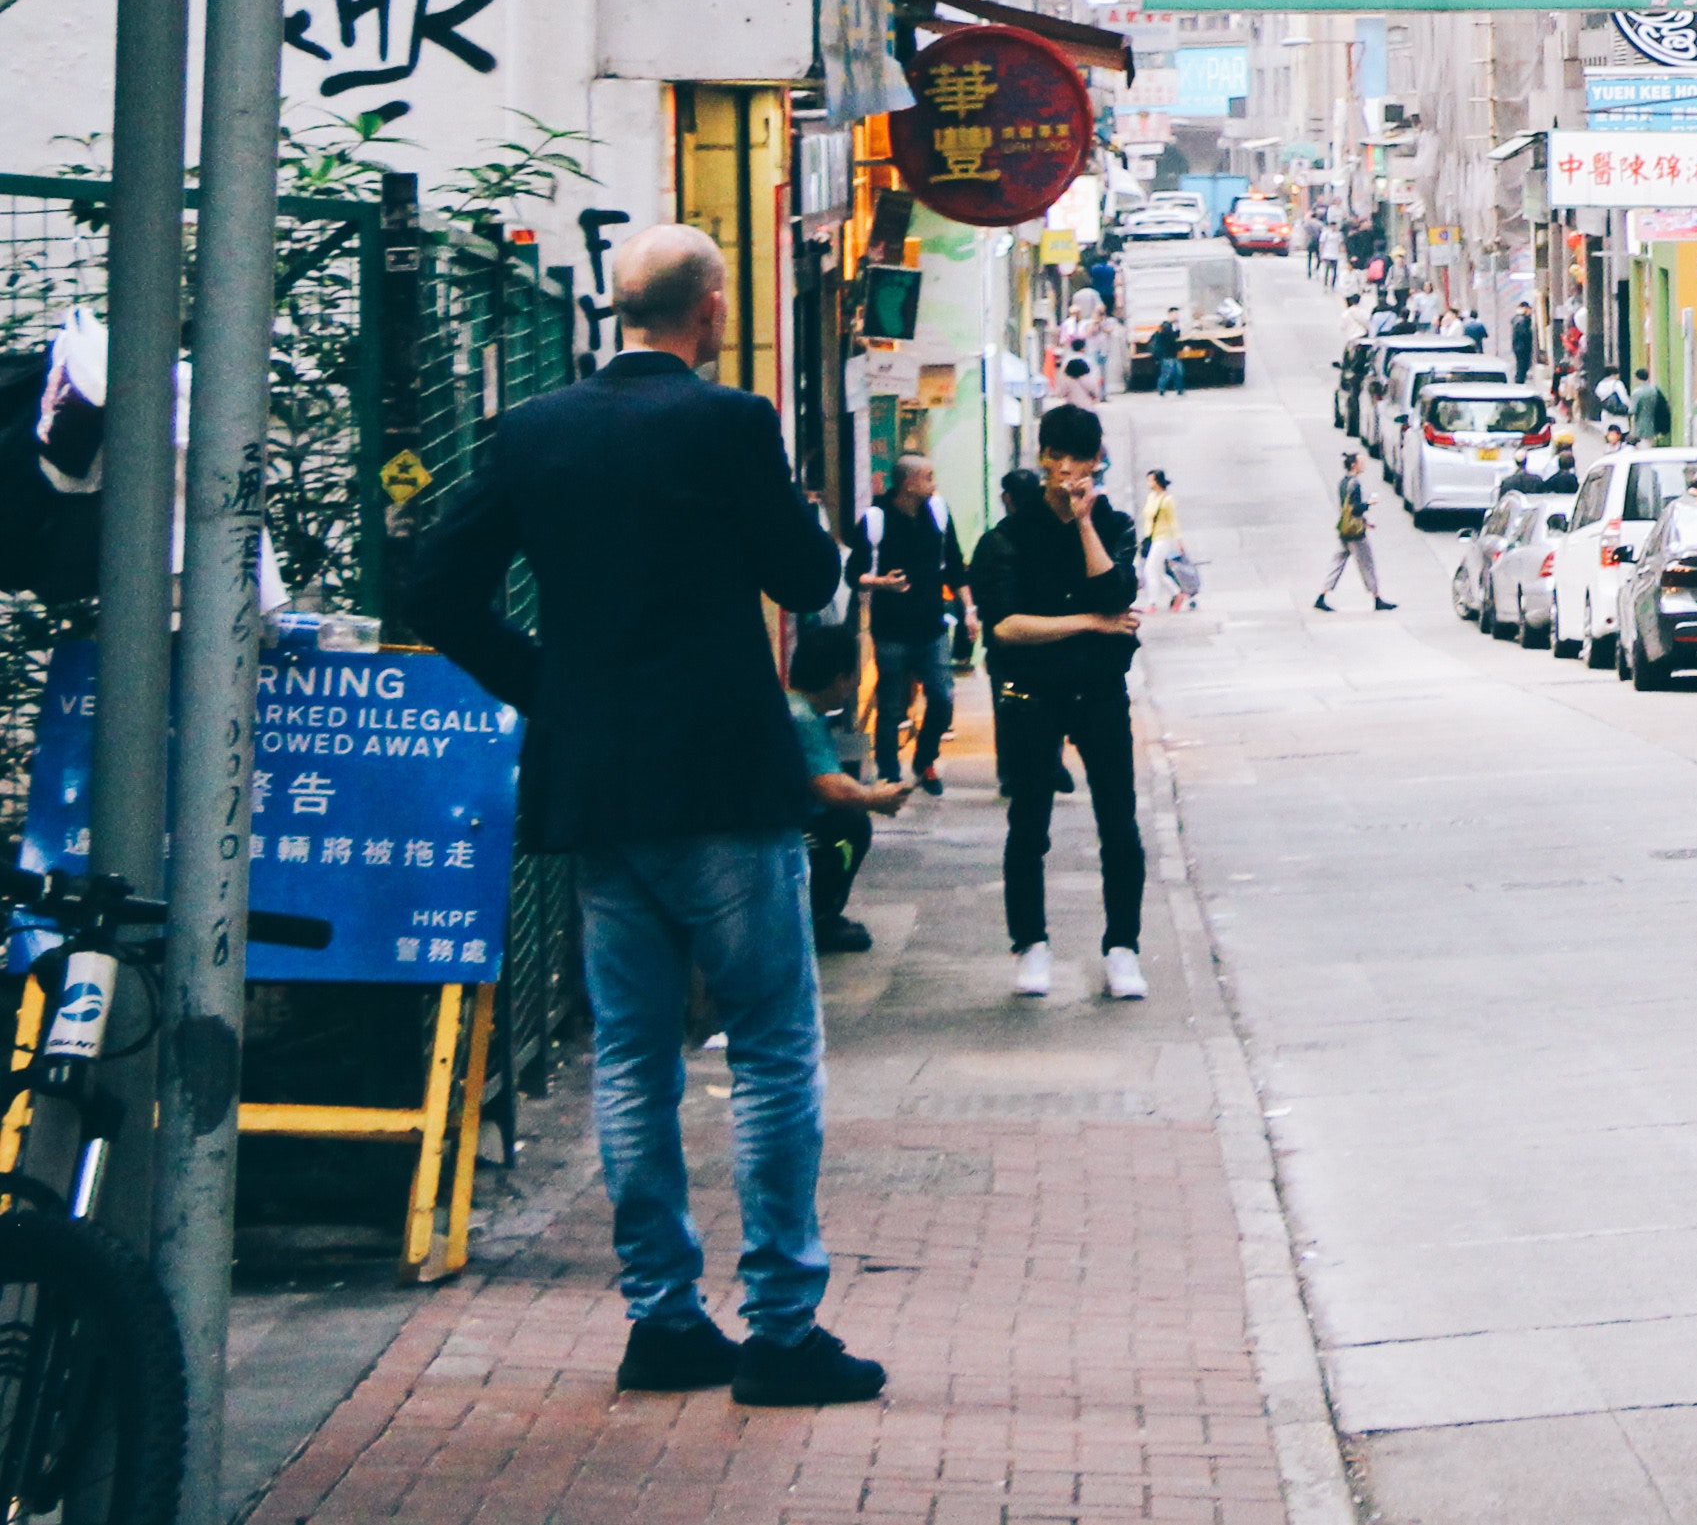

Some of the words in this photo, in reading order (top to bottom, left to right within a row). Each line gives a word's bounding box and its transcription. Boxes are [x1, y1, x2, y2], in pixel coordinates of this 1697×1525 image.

[1639, 84, 1673, 100] KEE
[363, 733, 451, 760] AWAY
[412, 908, 478, 928] HKPF
